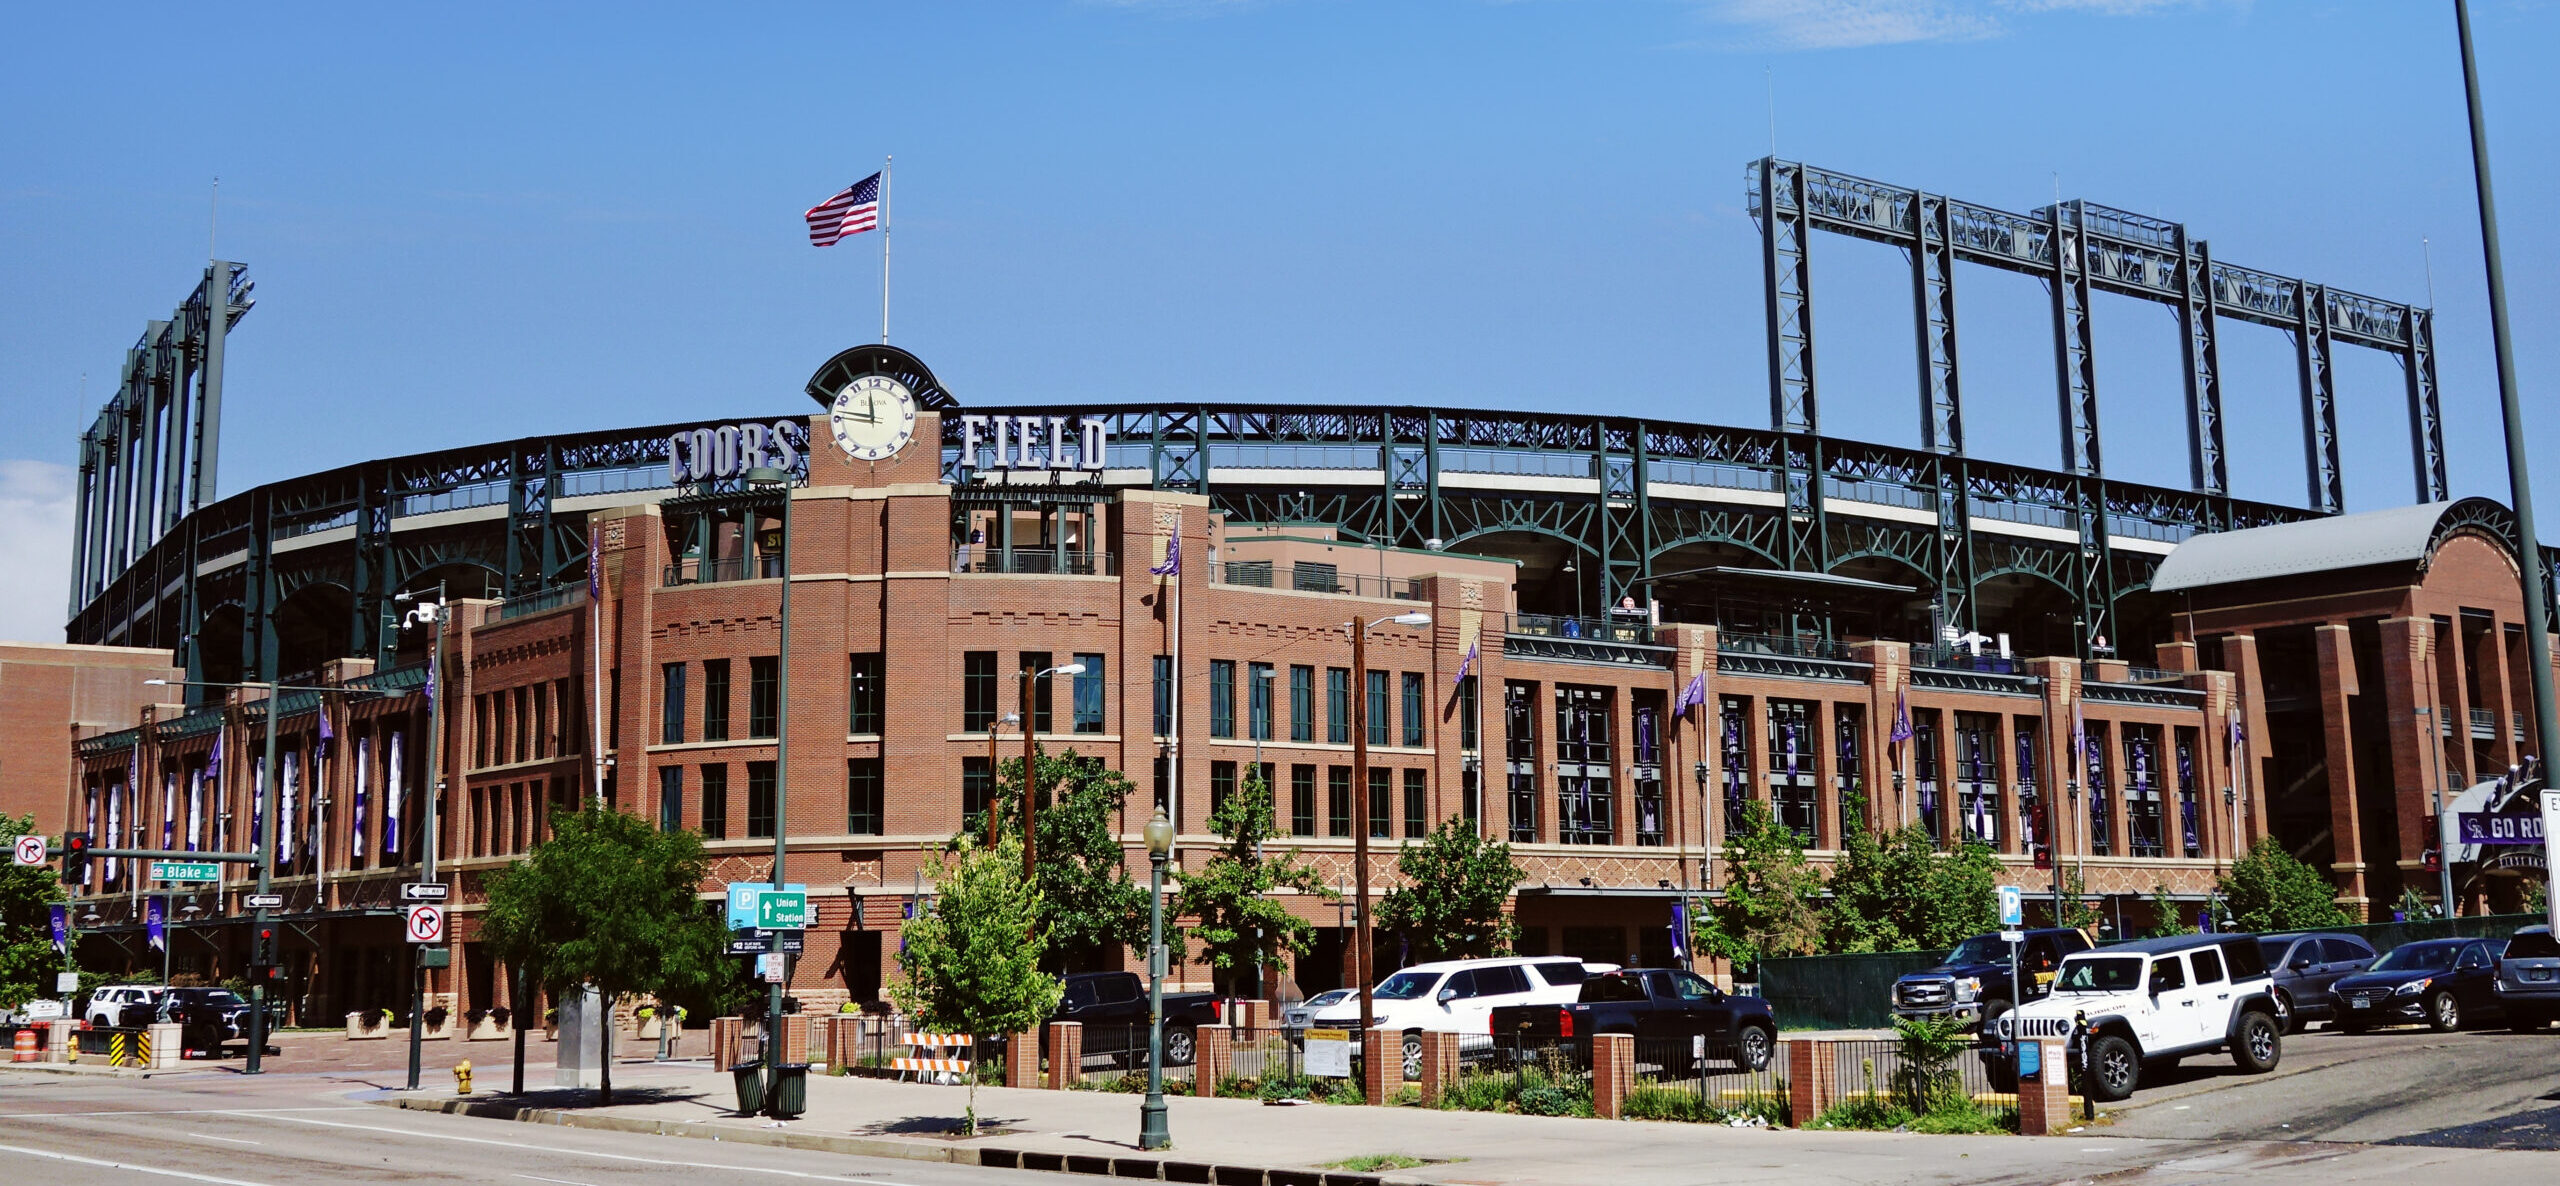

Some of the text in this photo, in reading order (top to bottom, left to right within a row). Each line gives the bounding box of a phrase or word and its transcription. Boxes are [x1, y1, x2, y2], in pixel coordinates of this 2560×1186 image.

[850, 383, 861, 393] 11
[868, 379, 880, 388] 12
[888, 382, 895, 390] 1
[837, 395, 848, 406] 10
[900, 395, 908, 404] 2
[834, 415, 842, 423] 9
[838, 432, 846, 440] 8
[900, 431, 908, 440] 4
[669, 414, 1108, 484] COORS FIELD
[851, 444, 860, 453] 7
[887, 443, 894, 452] 5
[869, 449, 877, 457] 6
[2492, 818, 2514, 838] GO
[168, 866, 201, 878] Blake
[742, 892, 750, 906] P
[776, 899, 797, 907] Union
[2005, 892, 2018, 917] P
[776, 913, 803, 922] Station
